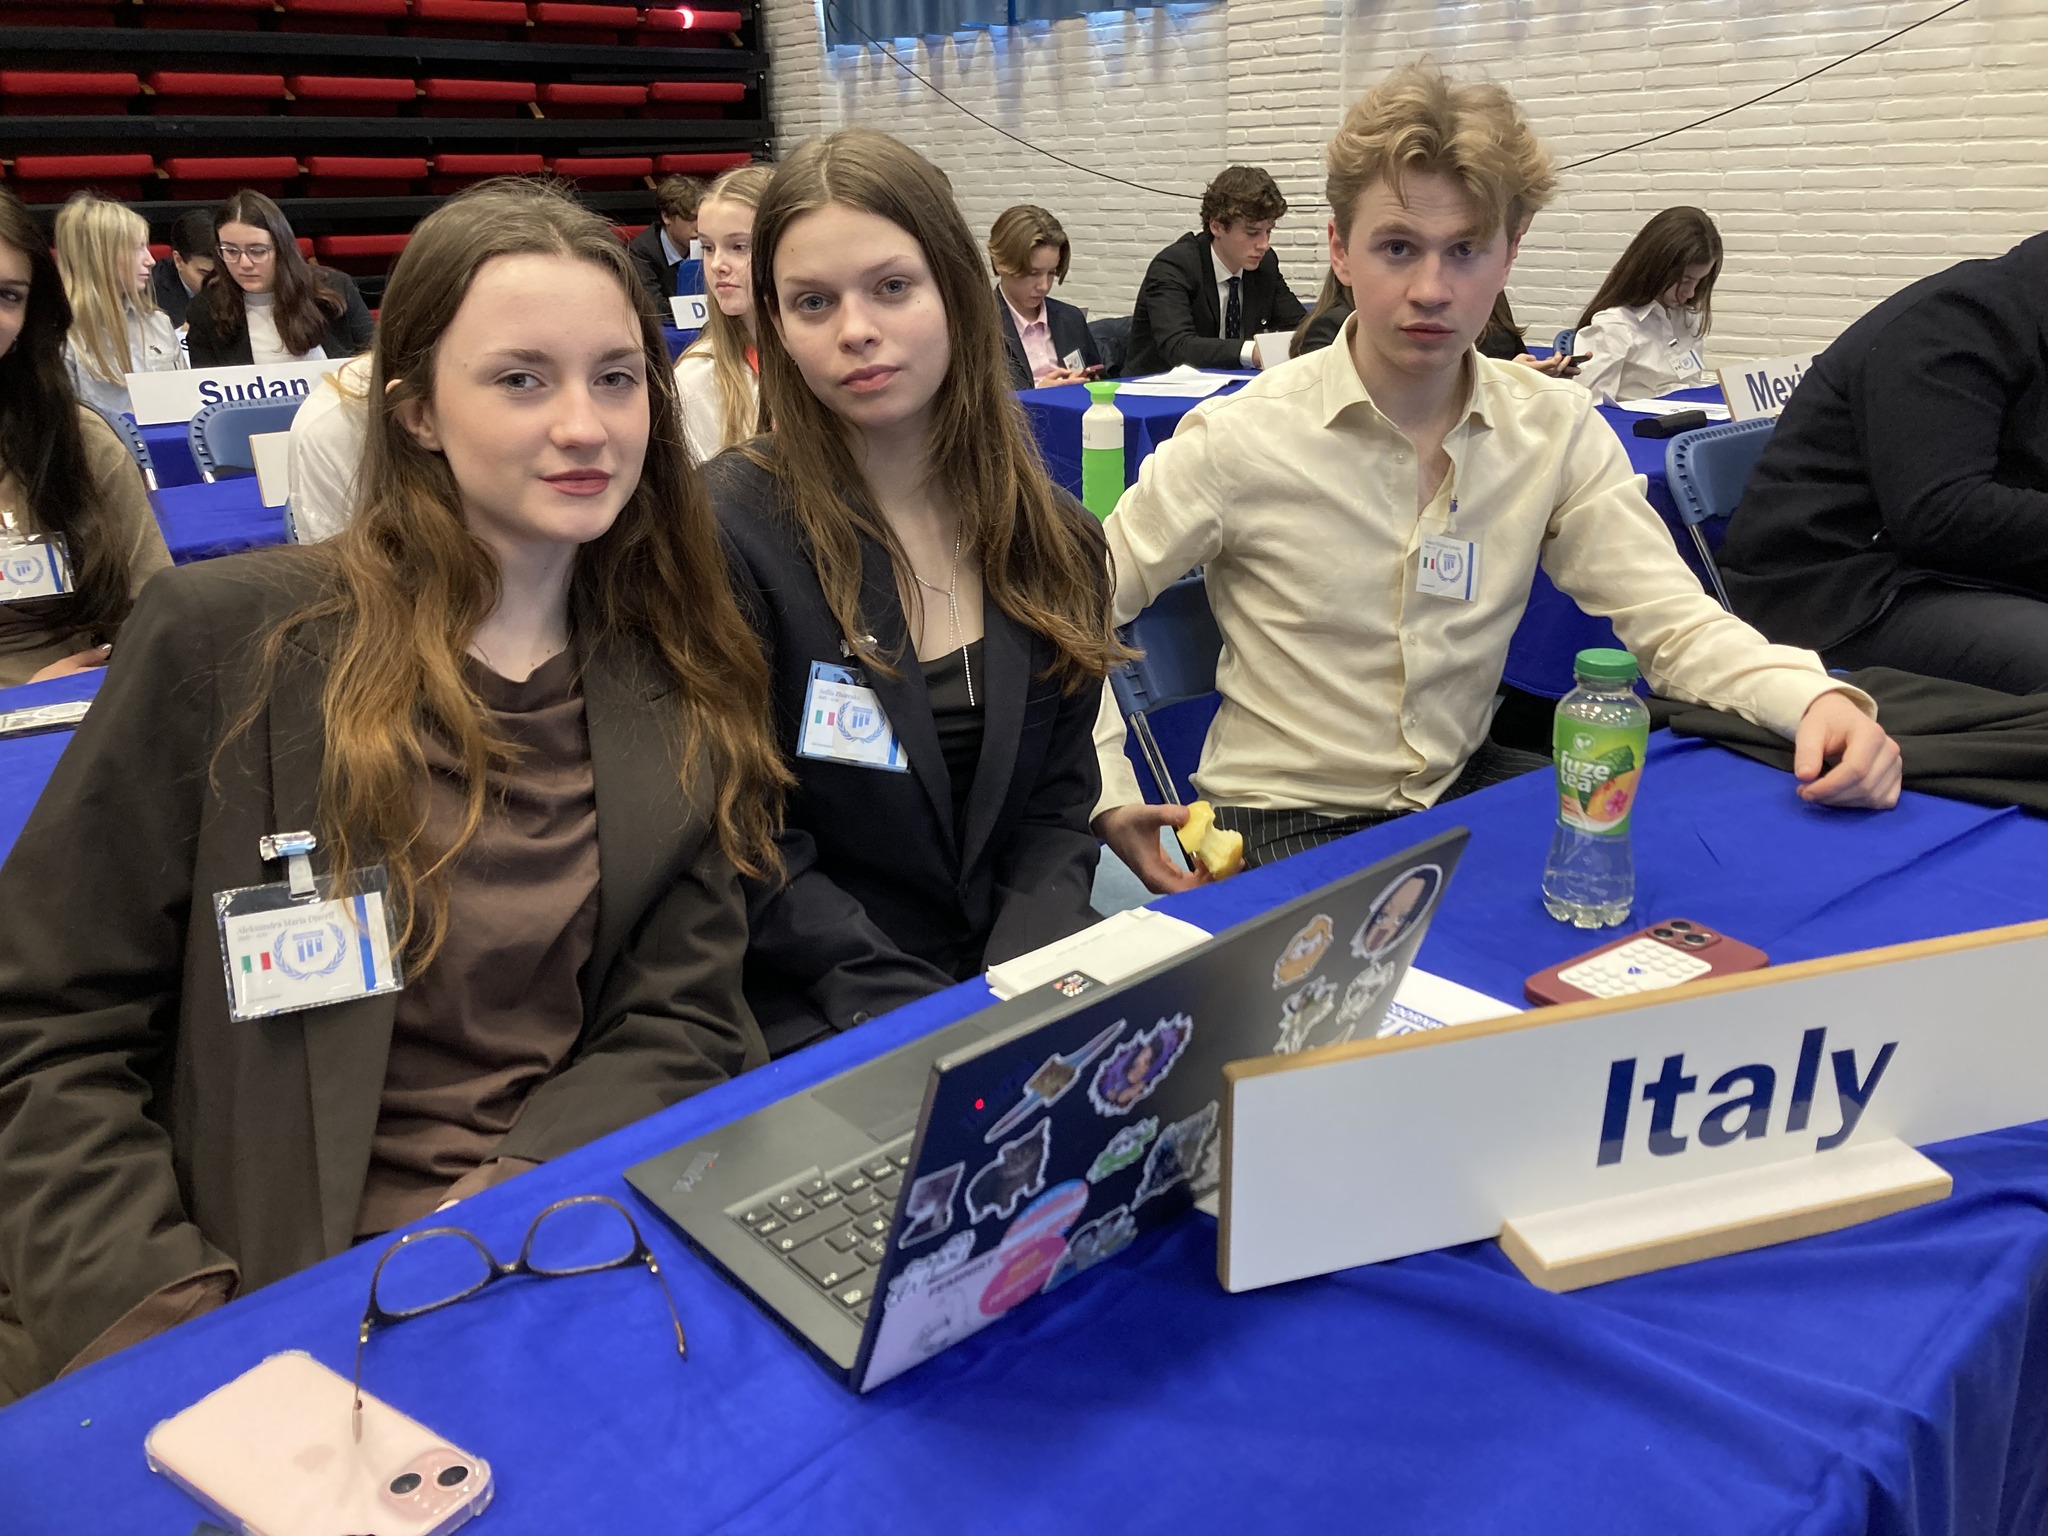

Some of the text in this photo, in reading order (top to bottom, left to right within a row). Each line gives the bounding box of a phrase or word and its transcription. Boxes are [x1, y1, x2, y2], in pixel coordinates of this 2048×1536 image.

[691, 302, 706, 319] D
[198, 376, 310, 406] Sudan
[1561, 750, 1610, 781] fuze
[1561, 770, 1592, 794] tea
[1597, 1026, 1899, 1168] Italy
